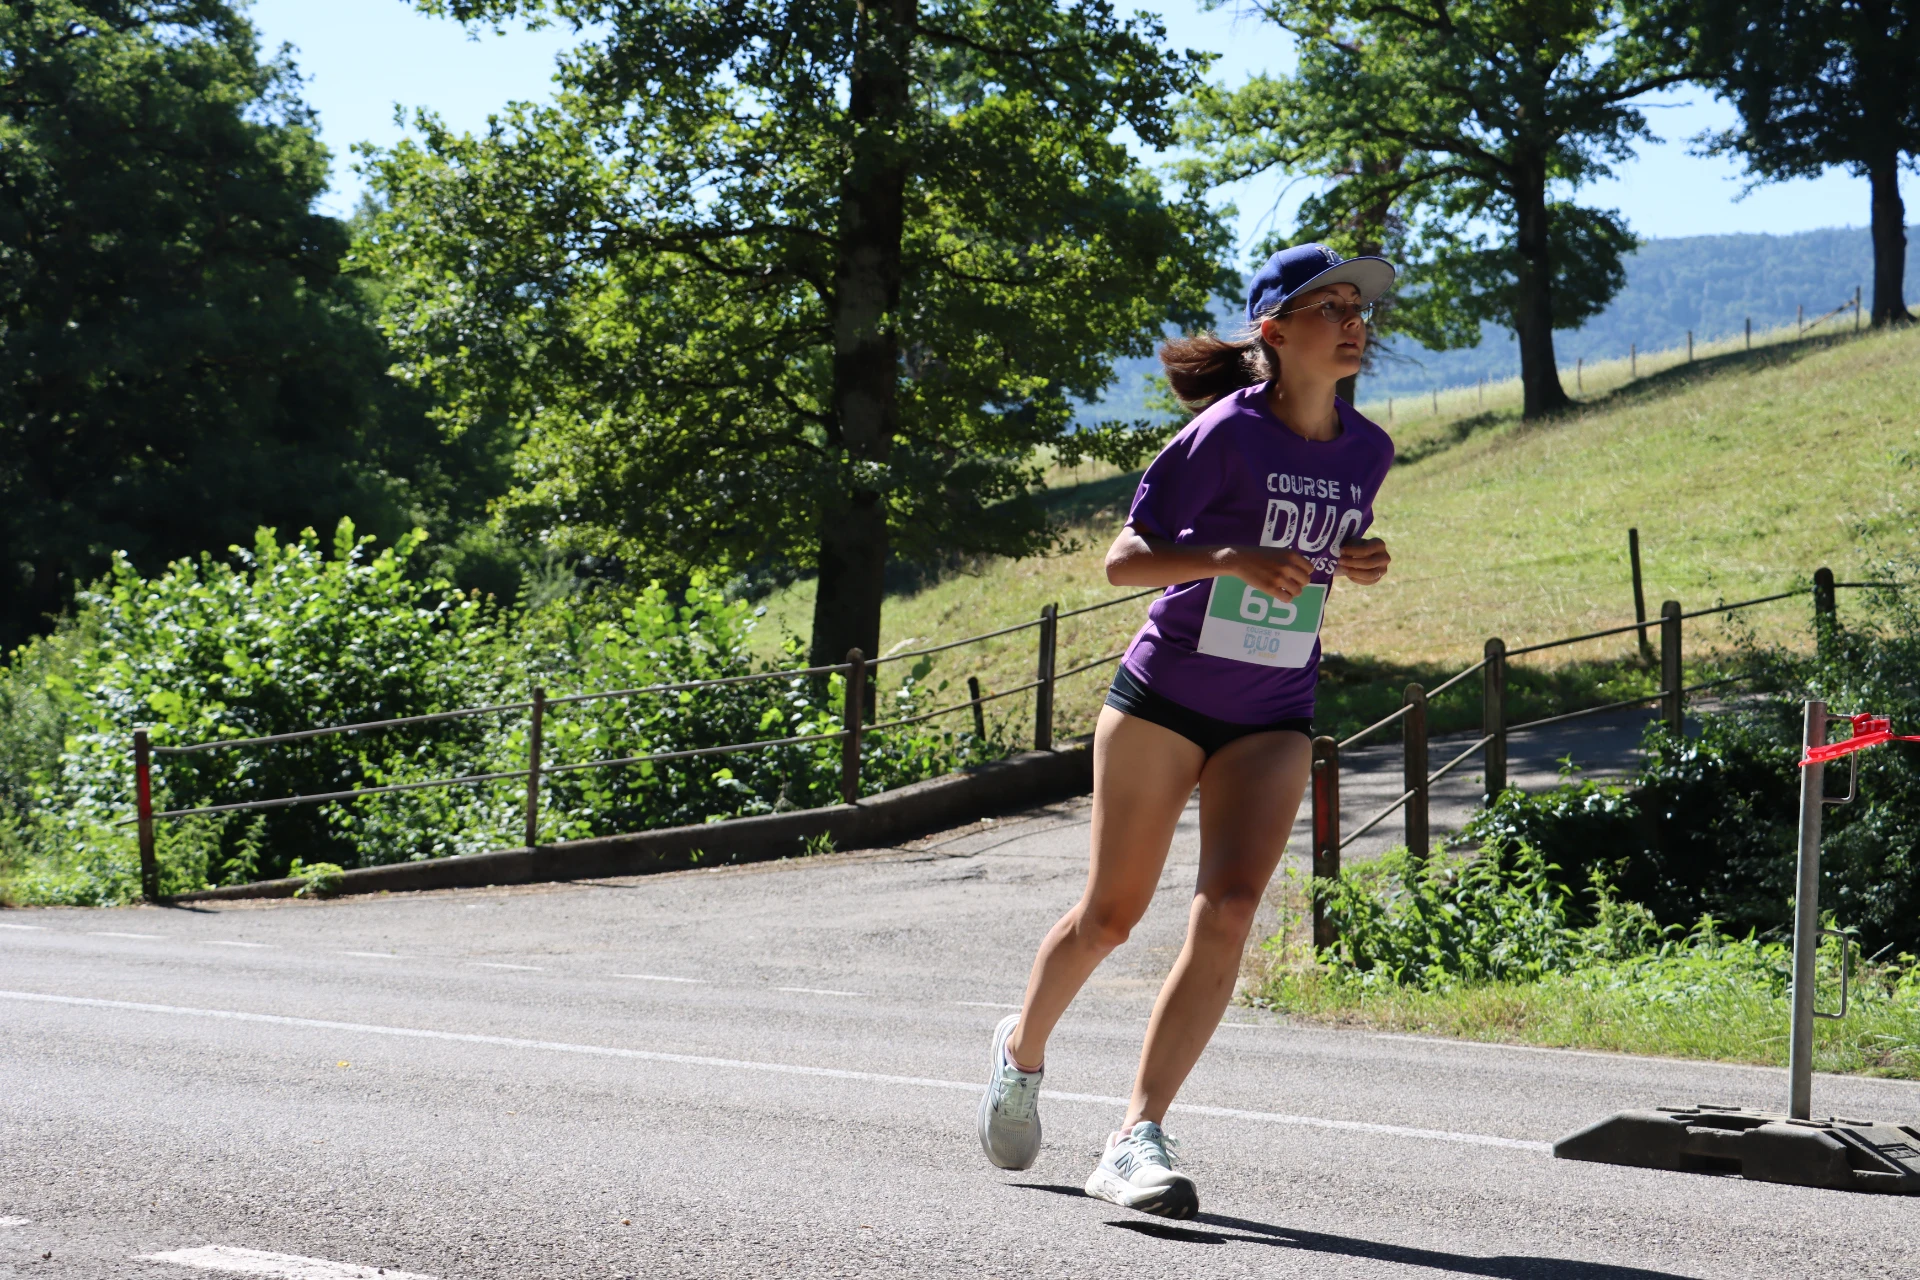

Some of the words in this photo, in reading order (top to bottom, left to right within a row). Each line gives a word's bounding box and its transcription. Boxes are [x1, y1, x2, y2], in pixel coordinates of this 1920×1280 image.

[1267, 472, 1341, 500] COURSE
[1259, 498, 1363, 558] DUO
[1239, 584, 1298, 626] 65
[1243, 633, 1280, 653] DUO
